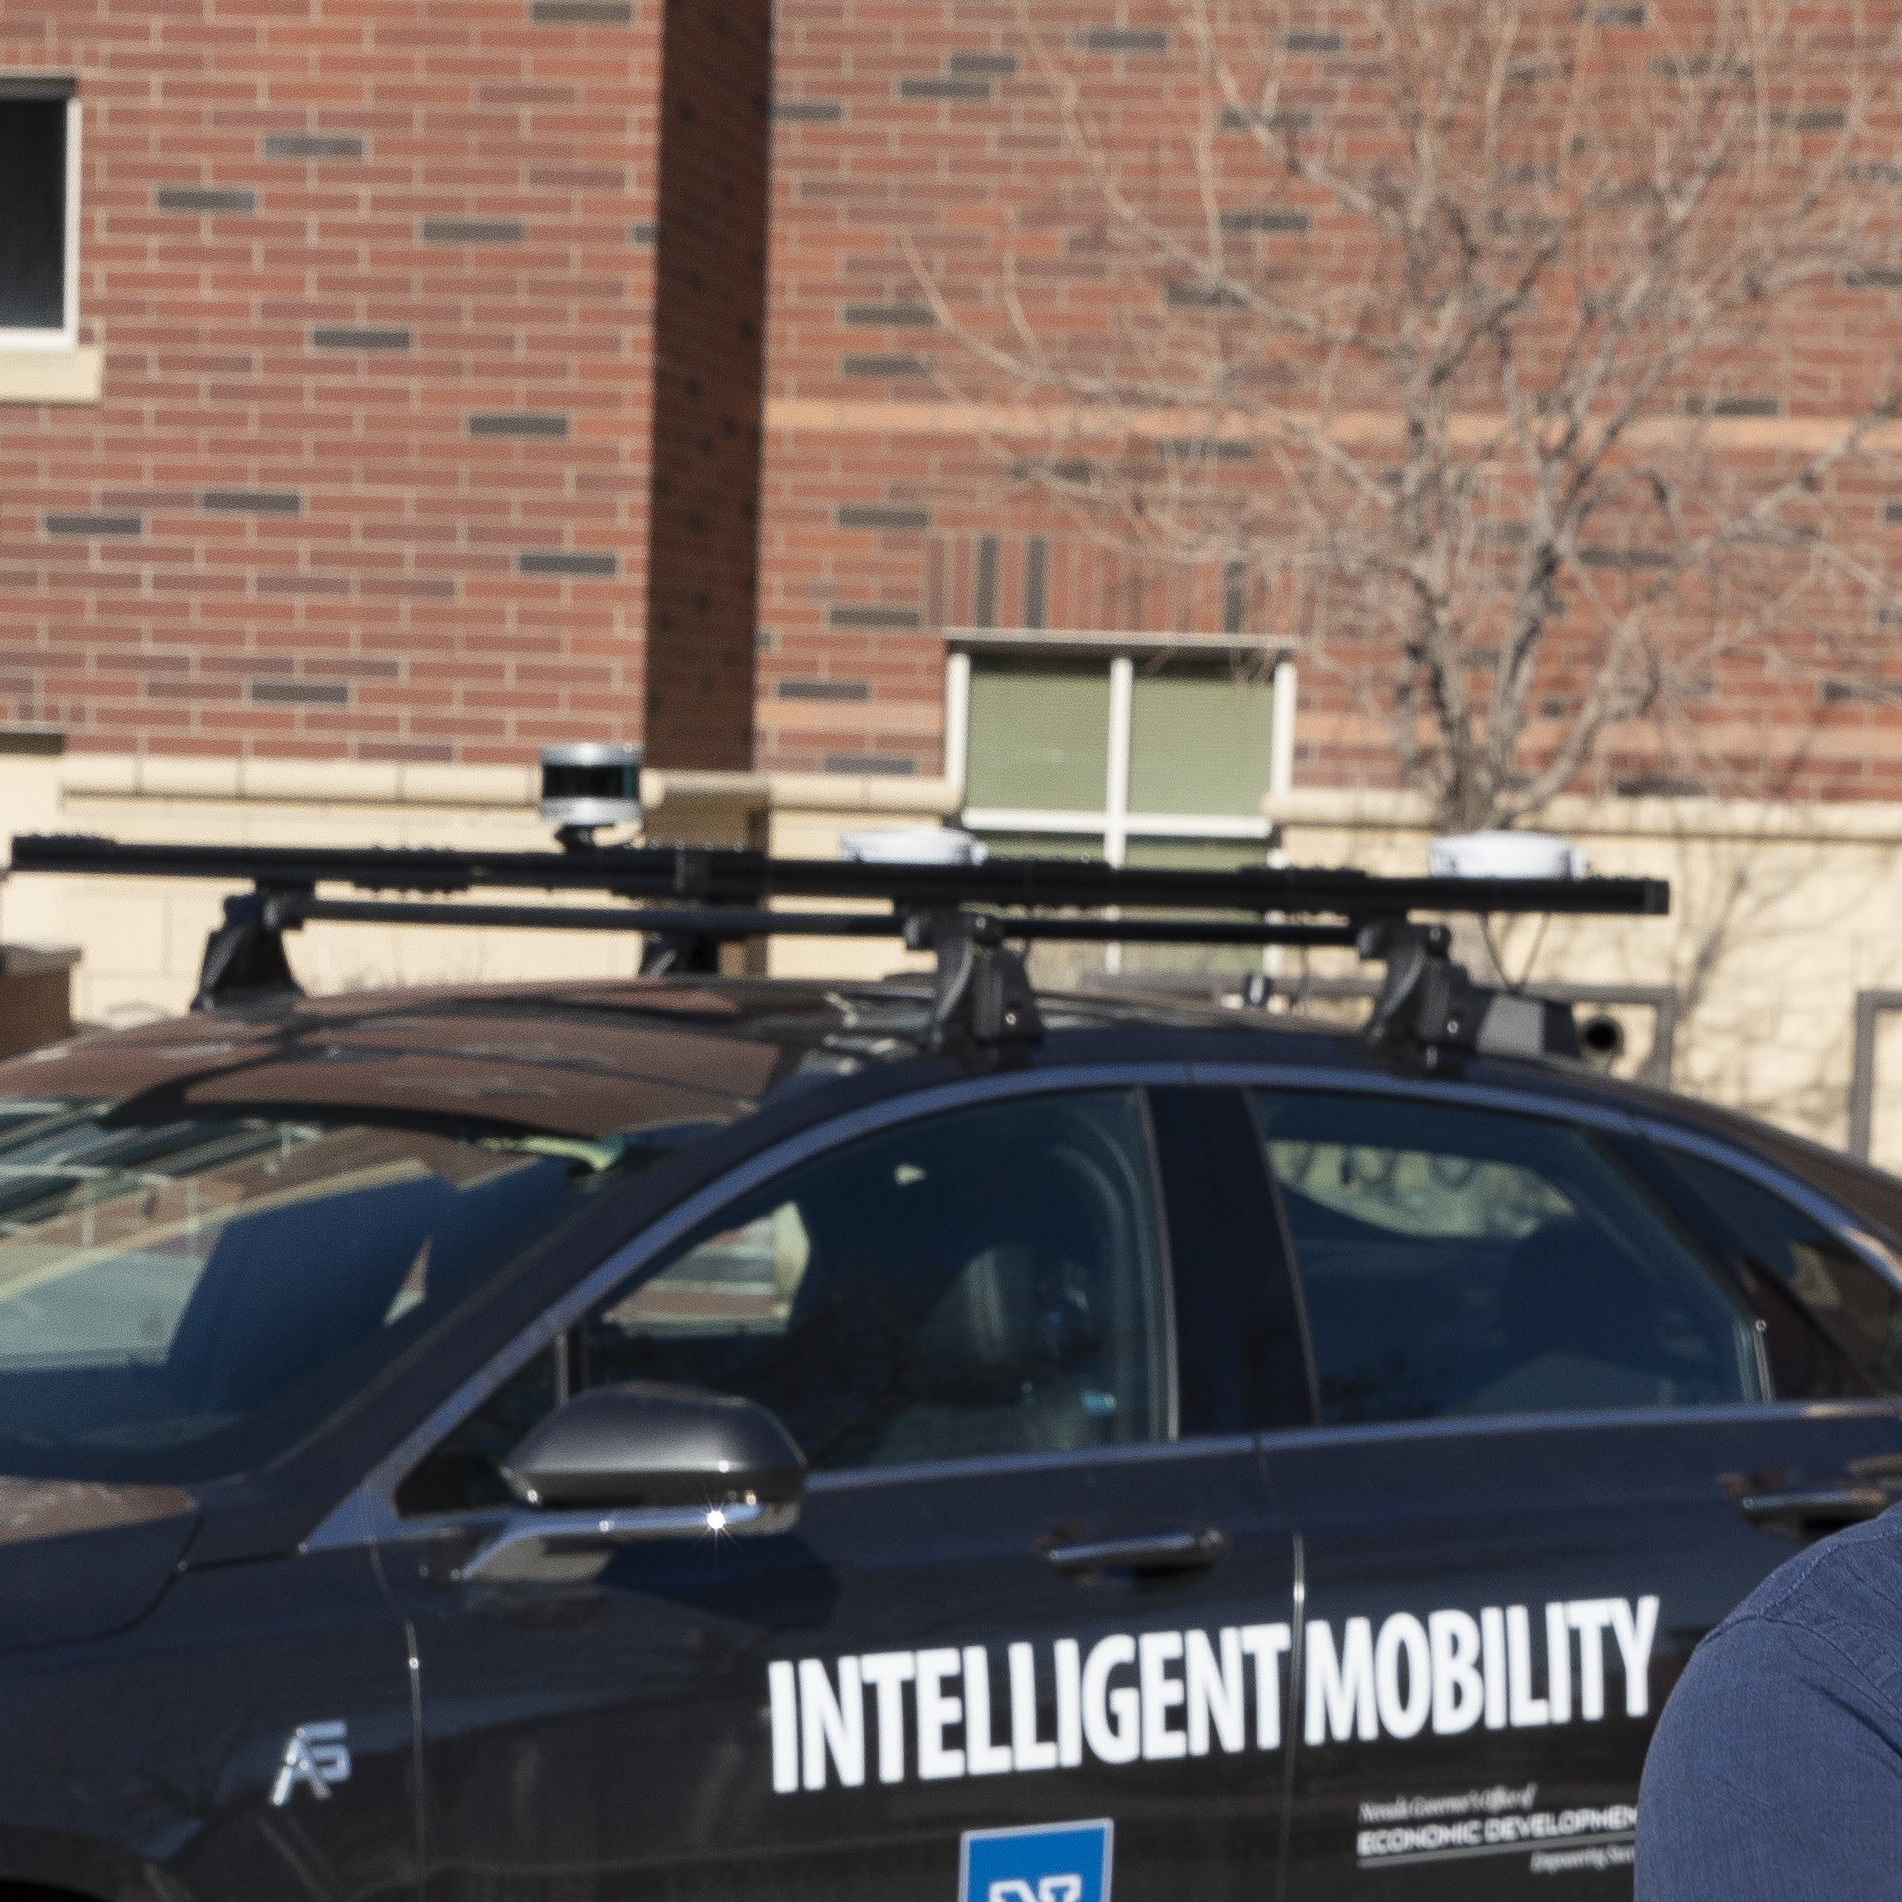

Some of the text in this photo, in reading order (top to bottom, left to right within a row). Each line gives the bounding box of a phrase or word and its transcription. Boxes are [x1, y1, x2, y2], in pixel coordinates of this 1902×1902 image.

[768, 1595, 1659, 1795] INTELLIGENT MOBILITY
[1357, 1804, 1637, 1857] ECONOMIC DEVELOPMEN
